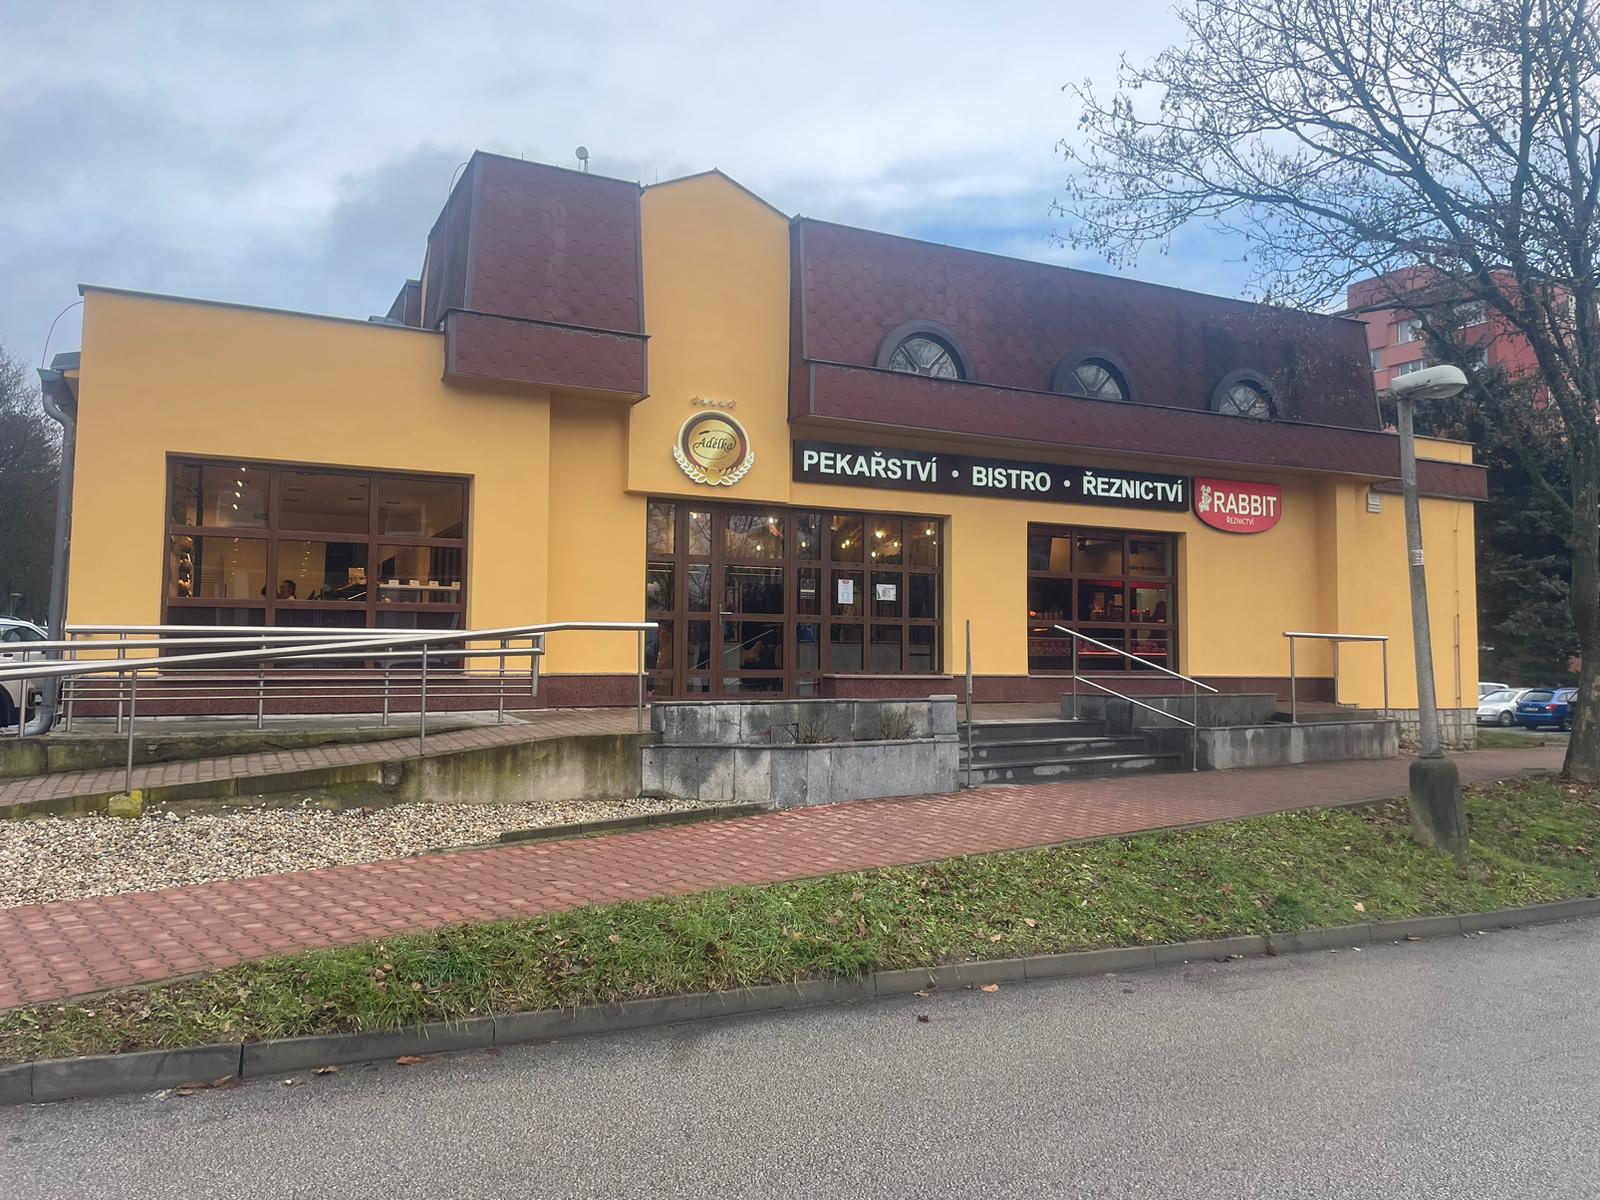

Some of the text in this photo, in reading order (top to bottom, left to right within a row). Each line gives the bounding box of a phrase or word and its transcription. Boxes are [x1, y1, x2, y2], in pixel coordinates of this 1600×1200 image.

[803, 450, 1183, 503] PEKAŘSTVÍ BISTRO ŘEZNICTVÍ
[1213, 491, 1277, 517] RABBIT
[1226, 515, 1255, 526] ŘEZNICTVÍ
